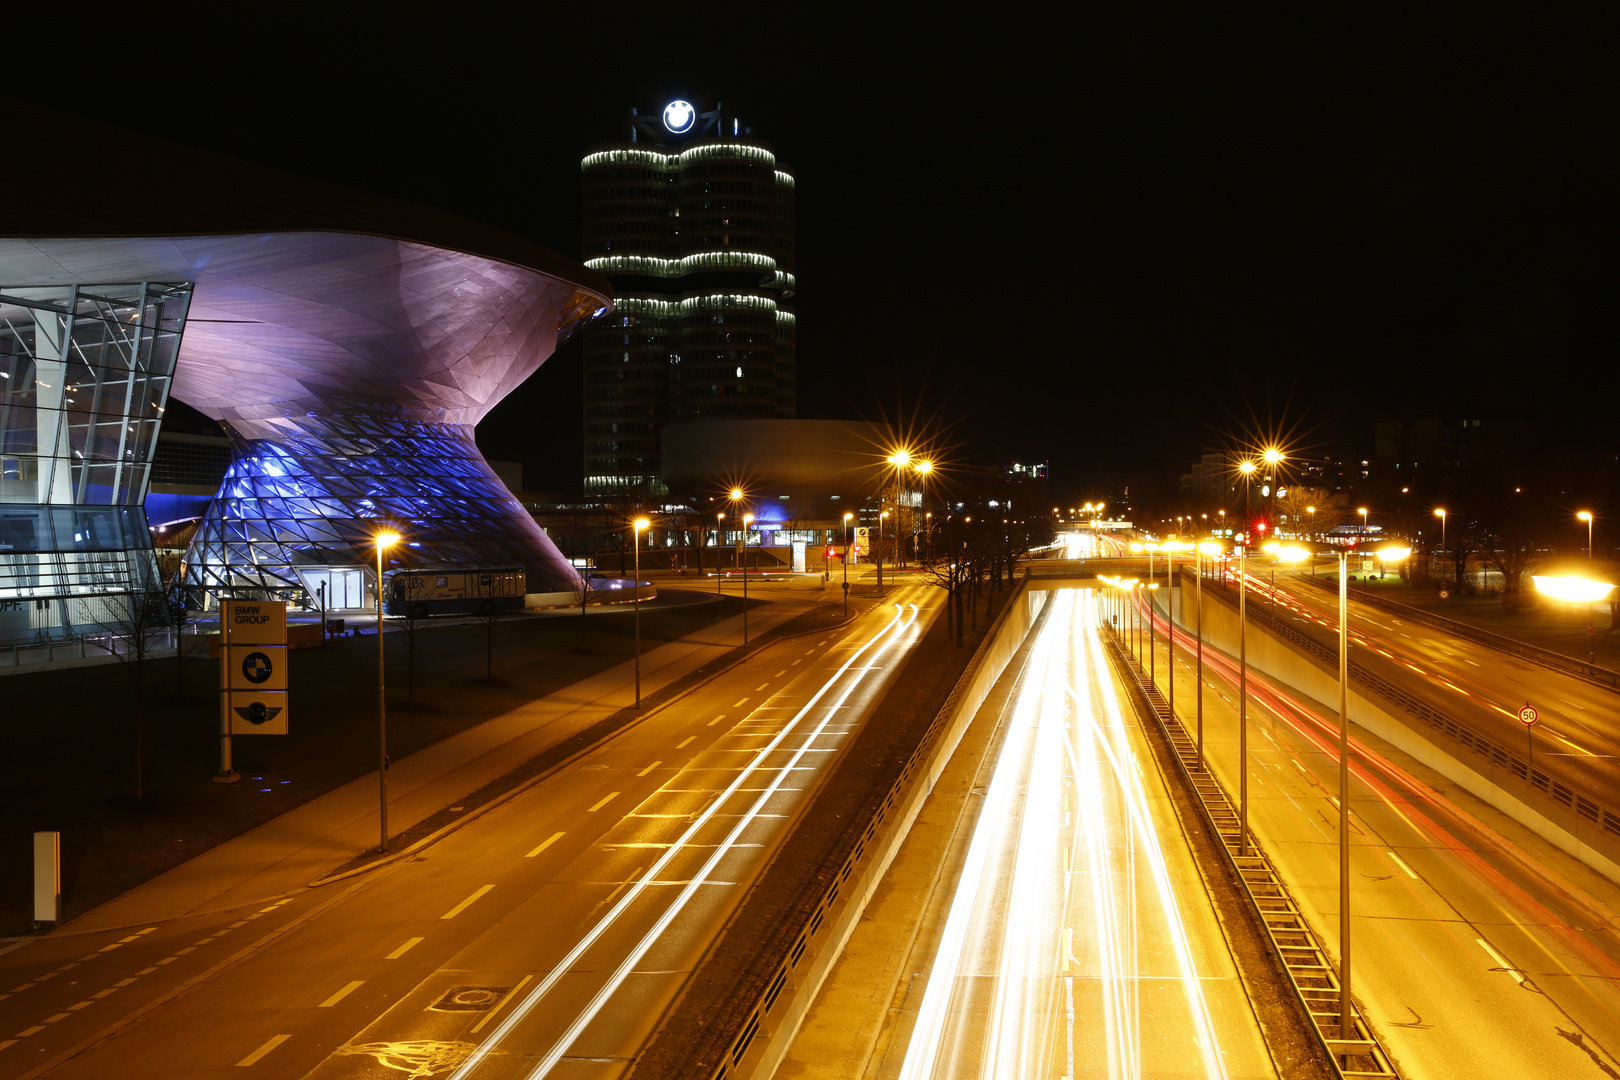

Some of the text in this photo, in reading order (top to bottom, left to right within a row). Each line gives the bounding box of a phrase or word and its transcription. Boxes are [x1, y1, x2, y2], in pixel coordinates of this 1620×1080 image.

[412, 577, 425, 589] BR
[235, 606, 260, 615] BMW
[235, 615, 270, 624] GROUP
[1523, 711, 1534, 720] 50
